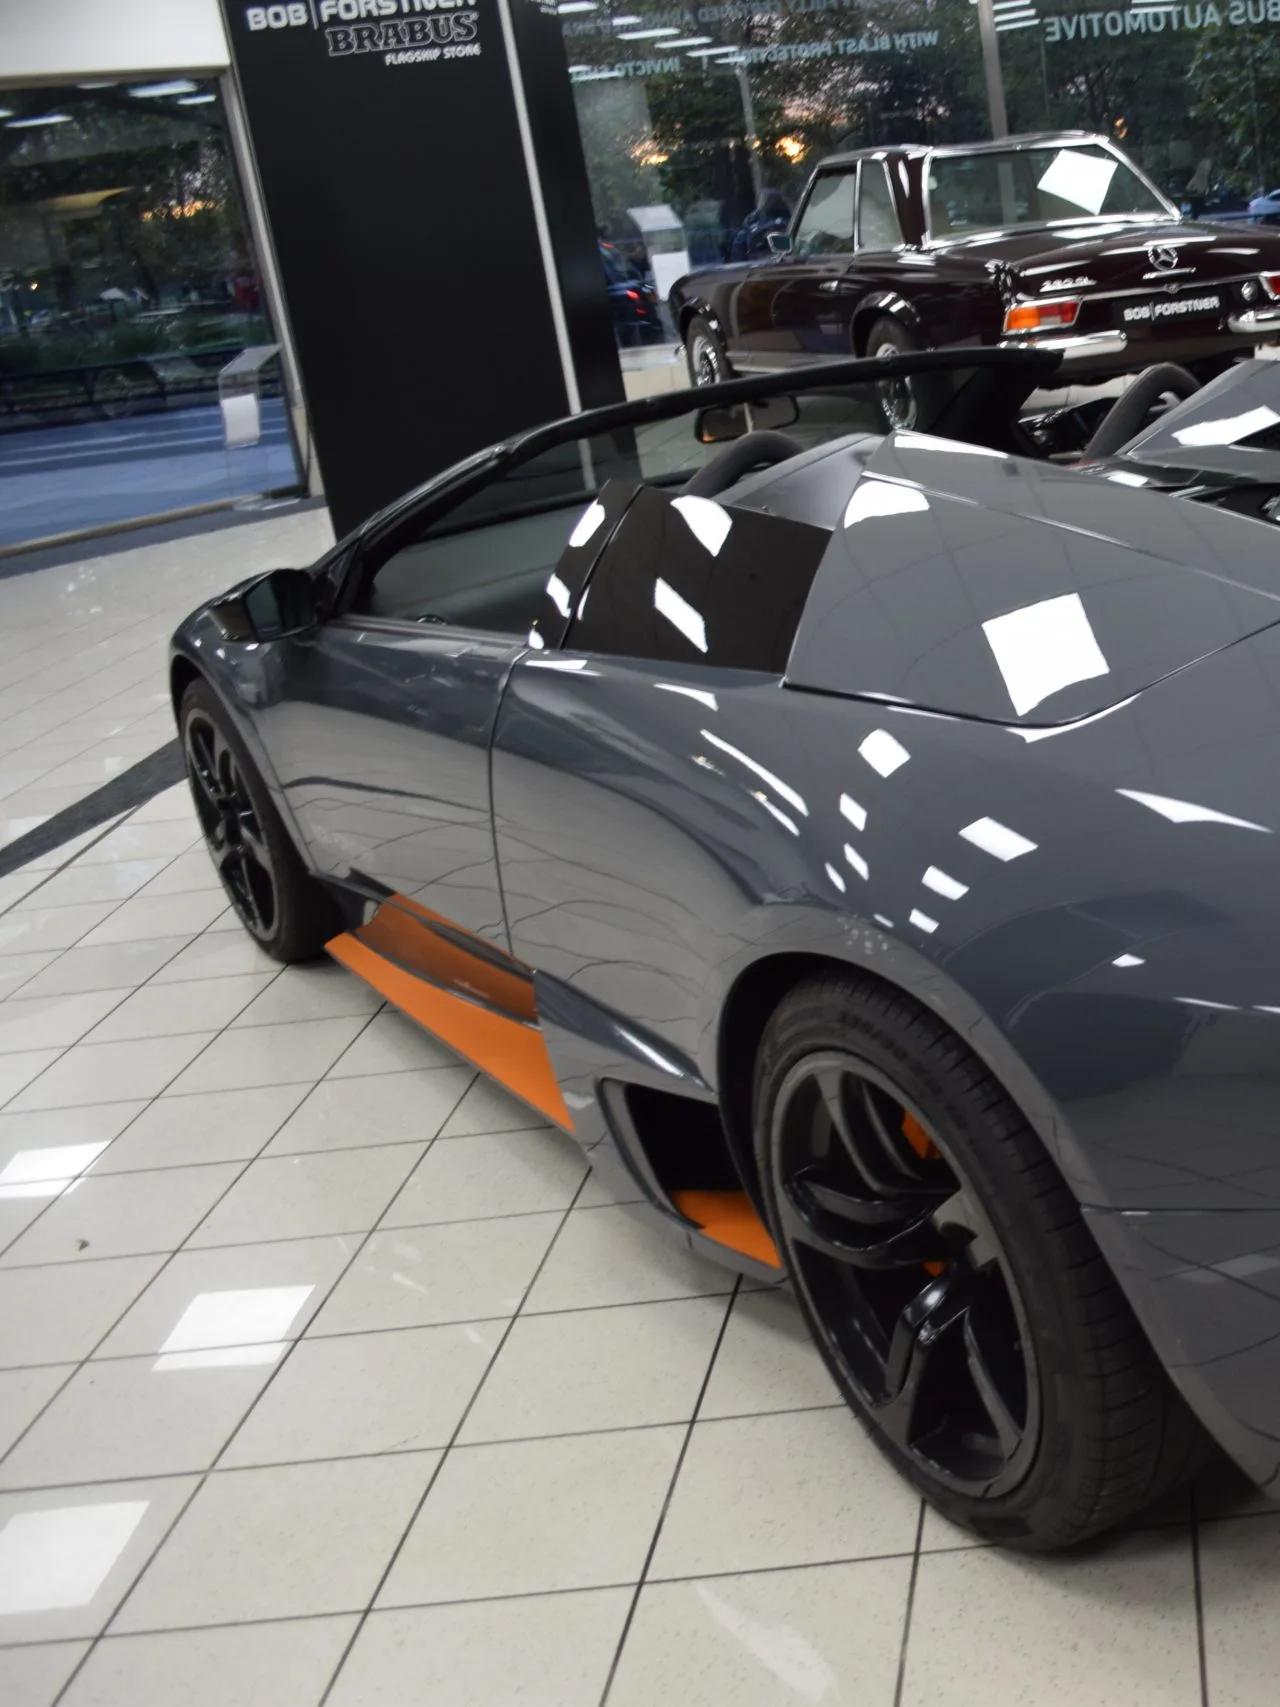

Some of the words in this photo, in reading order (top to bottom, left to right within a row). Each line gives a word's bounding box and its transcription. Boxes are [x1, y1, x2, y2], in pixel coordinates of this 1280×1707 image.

[246, 4, 308, 31] BOB
[319, 0, 477, 22] FORST
[325, 11, 479, 56] BRABUS
[384, 48, 441, 65] FLAGSHIP
[442, 42, 482, 59] STORE
[1123, 306, 1150, 321] BOB
[1154, 296, 1220, 317] FORSTNER
